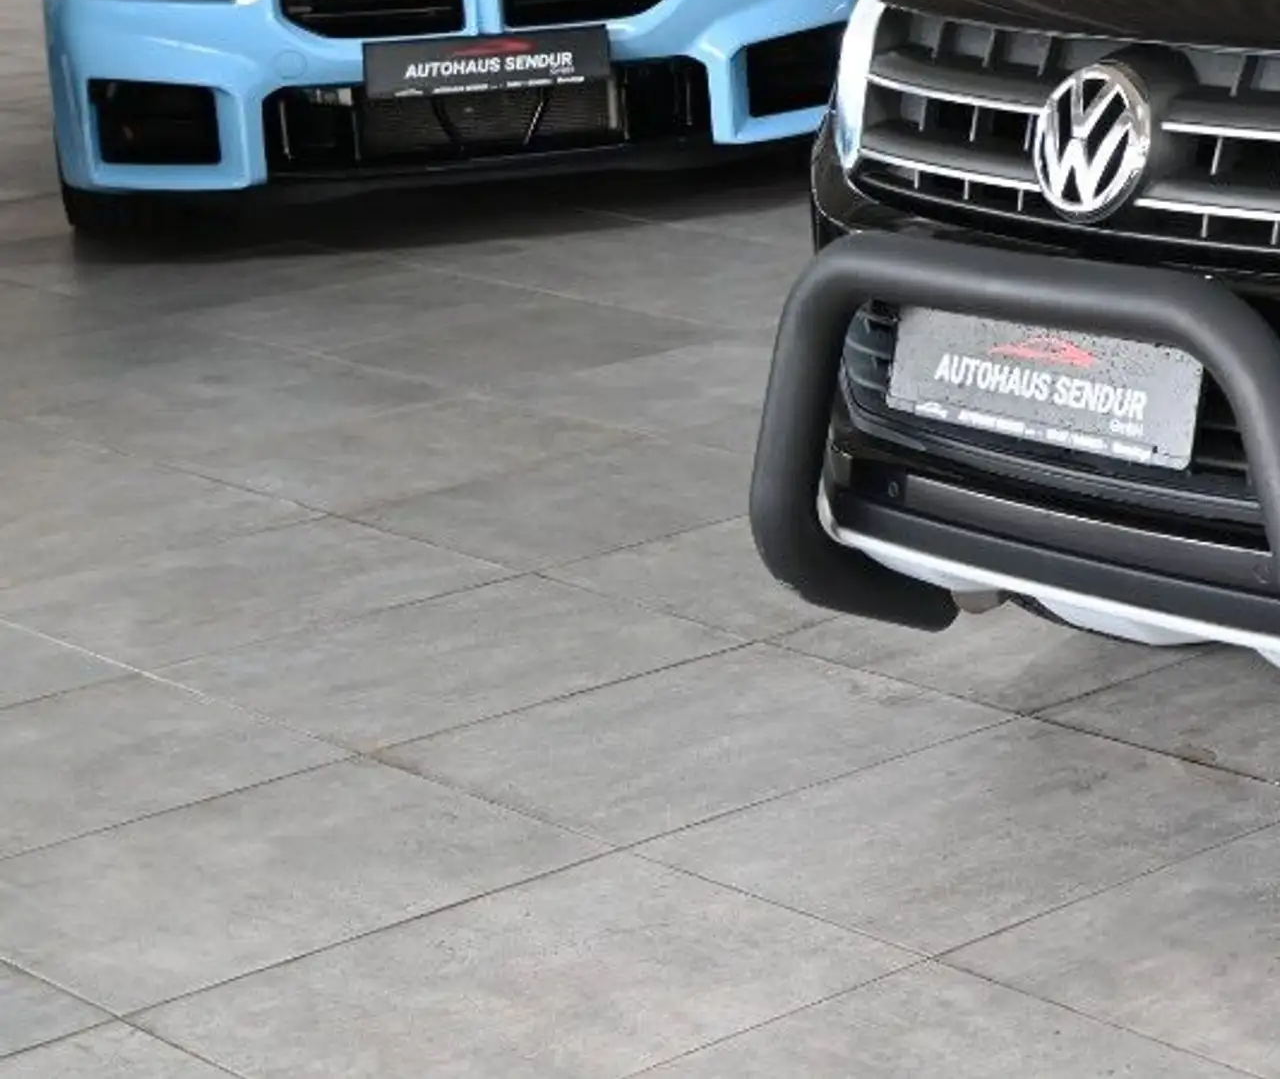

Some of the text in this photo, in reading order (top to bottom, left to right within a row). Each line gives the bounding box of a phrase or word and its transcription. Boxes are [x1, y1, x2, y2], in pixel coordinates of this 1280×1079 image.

[404, 51, 573, 80] AUTOHAUS SENDUR
[934, 353, 1149, 420] AUTOHAUS SENDUR
